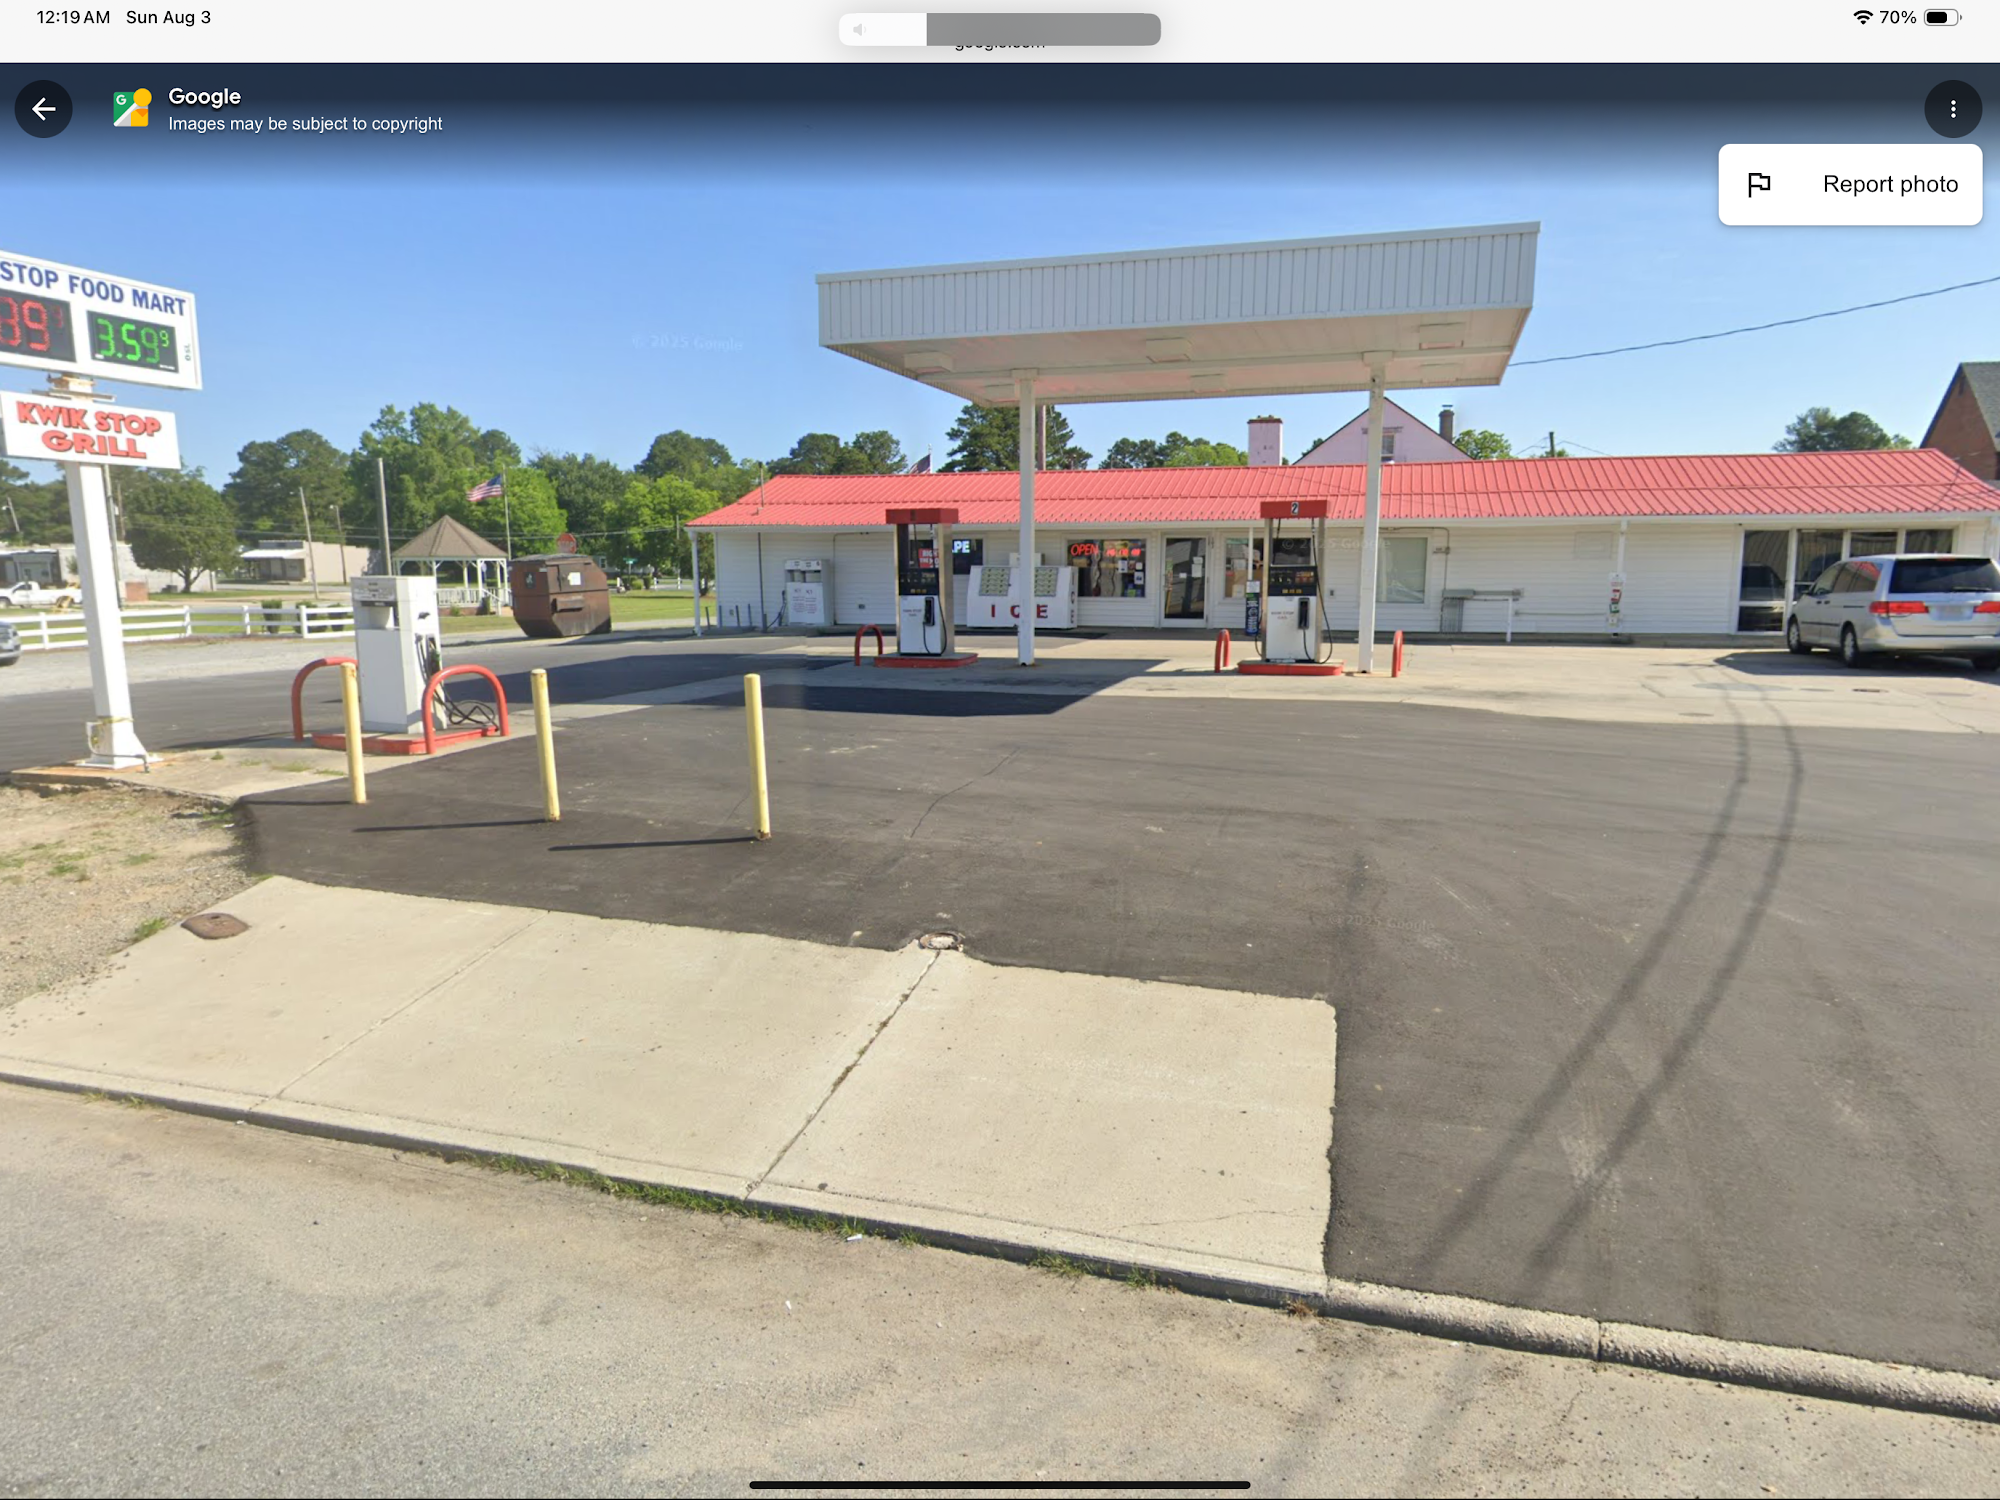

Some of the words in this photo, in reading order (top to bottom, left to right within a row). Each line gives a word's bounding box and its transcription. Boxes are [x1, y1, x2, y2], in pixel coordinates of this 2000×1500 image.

[0, 261, 59, 288] STOP
[69, 274, 125, 303] FOOD
[132, 289, 186, 316] MART
[16, 401, 90, 429] KWIK
[95, 411, 162, 437] STOP
[42, 430, 147, 459] GRILL
[1291, 502, 1299, 515] 2
[951, 540, 971, 554] PE
[1070, 543, 1099, 556] OPEN
